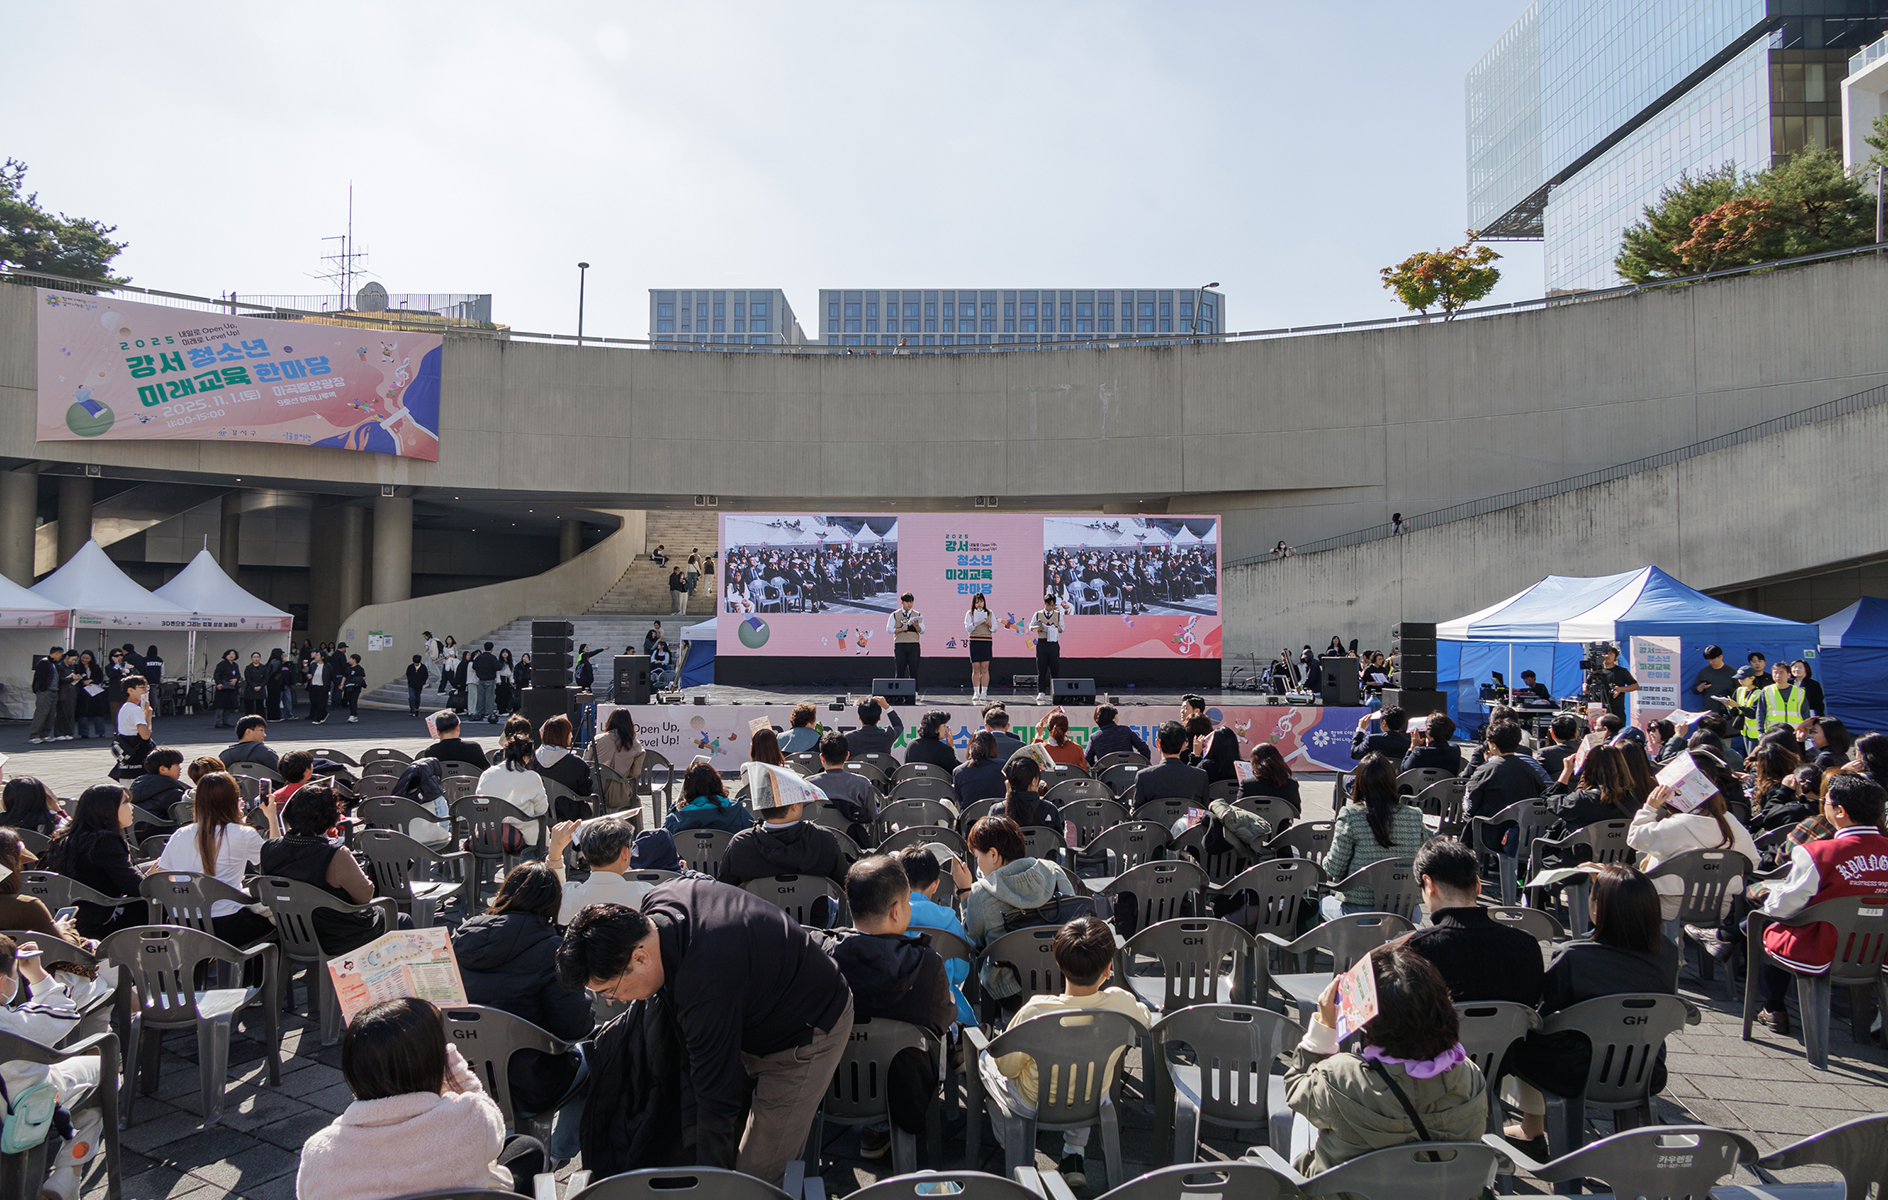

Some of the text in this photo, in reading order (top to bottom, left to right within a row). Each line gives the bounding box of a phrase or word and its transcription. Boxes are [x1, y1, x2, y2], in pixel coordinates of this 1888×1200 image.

[178, 329, 202, 338] 내일로
[202, 325, 224, 334] Open
[181, 329, 241, 346] 미래로 Level Up!
[119, 336, 175, 351] 2025
[125, 338, 271, 379] 강서 청소년
[137, 355, 332, 407] 미래교육 한마당
[272, 376, 345, 397] 마곡중앙광장
[276, 391, 338, 407] 9호선 마곡나루역
[162, 399, 211, 418] 2025.
[166, 409, 225, 428] 11:00-15:00
[945, 540, 969, 552] 강서
[957, 554, 993, 567] 청소년
[945, 568, 993, 581] 미래교육
[957, 582, 993, 595] 한마당
[1639, 663, 1671, 671] 미래교육
[1647, 671, 1671, 679] 한마당
[662, 722, 680, 733] Up,
[661, 735, 680, 745] Up!
[1703, 863, 1720, 871] GH
[1156, 876, 1173, 884] GH
[32, 885, 48, 894] GH
[173, 886, 190, 894] GH
[778, 886, 795, 894] GH
[1183, 937, 1204, 946] GH
[145, 945, 168, 954] GH
[1623, 1016, 1648, 1025] GH
[454, 1029, 477, 1039] GH
[1658, 1155, 1693, 1163] 카우렌탈
